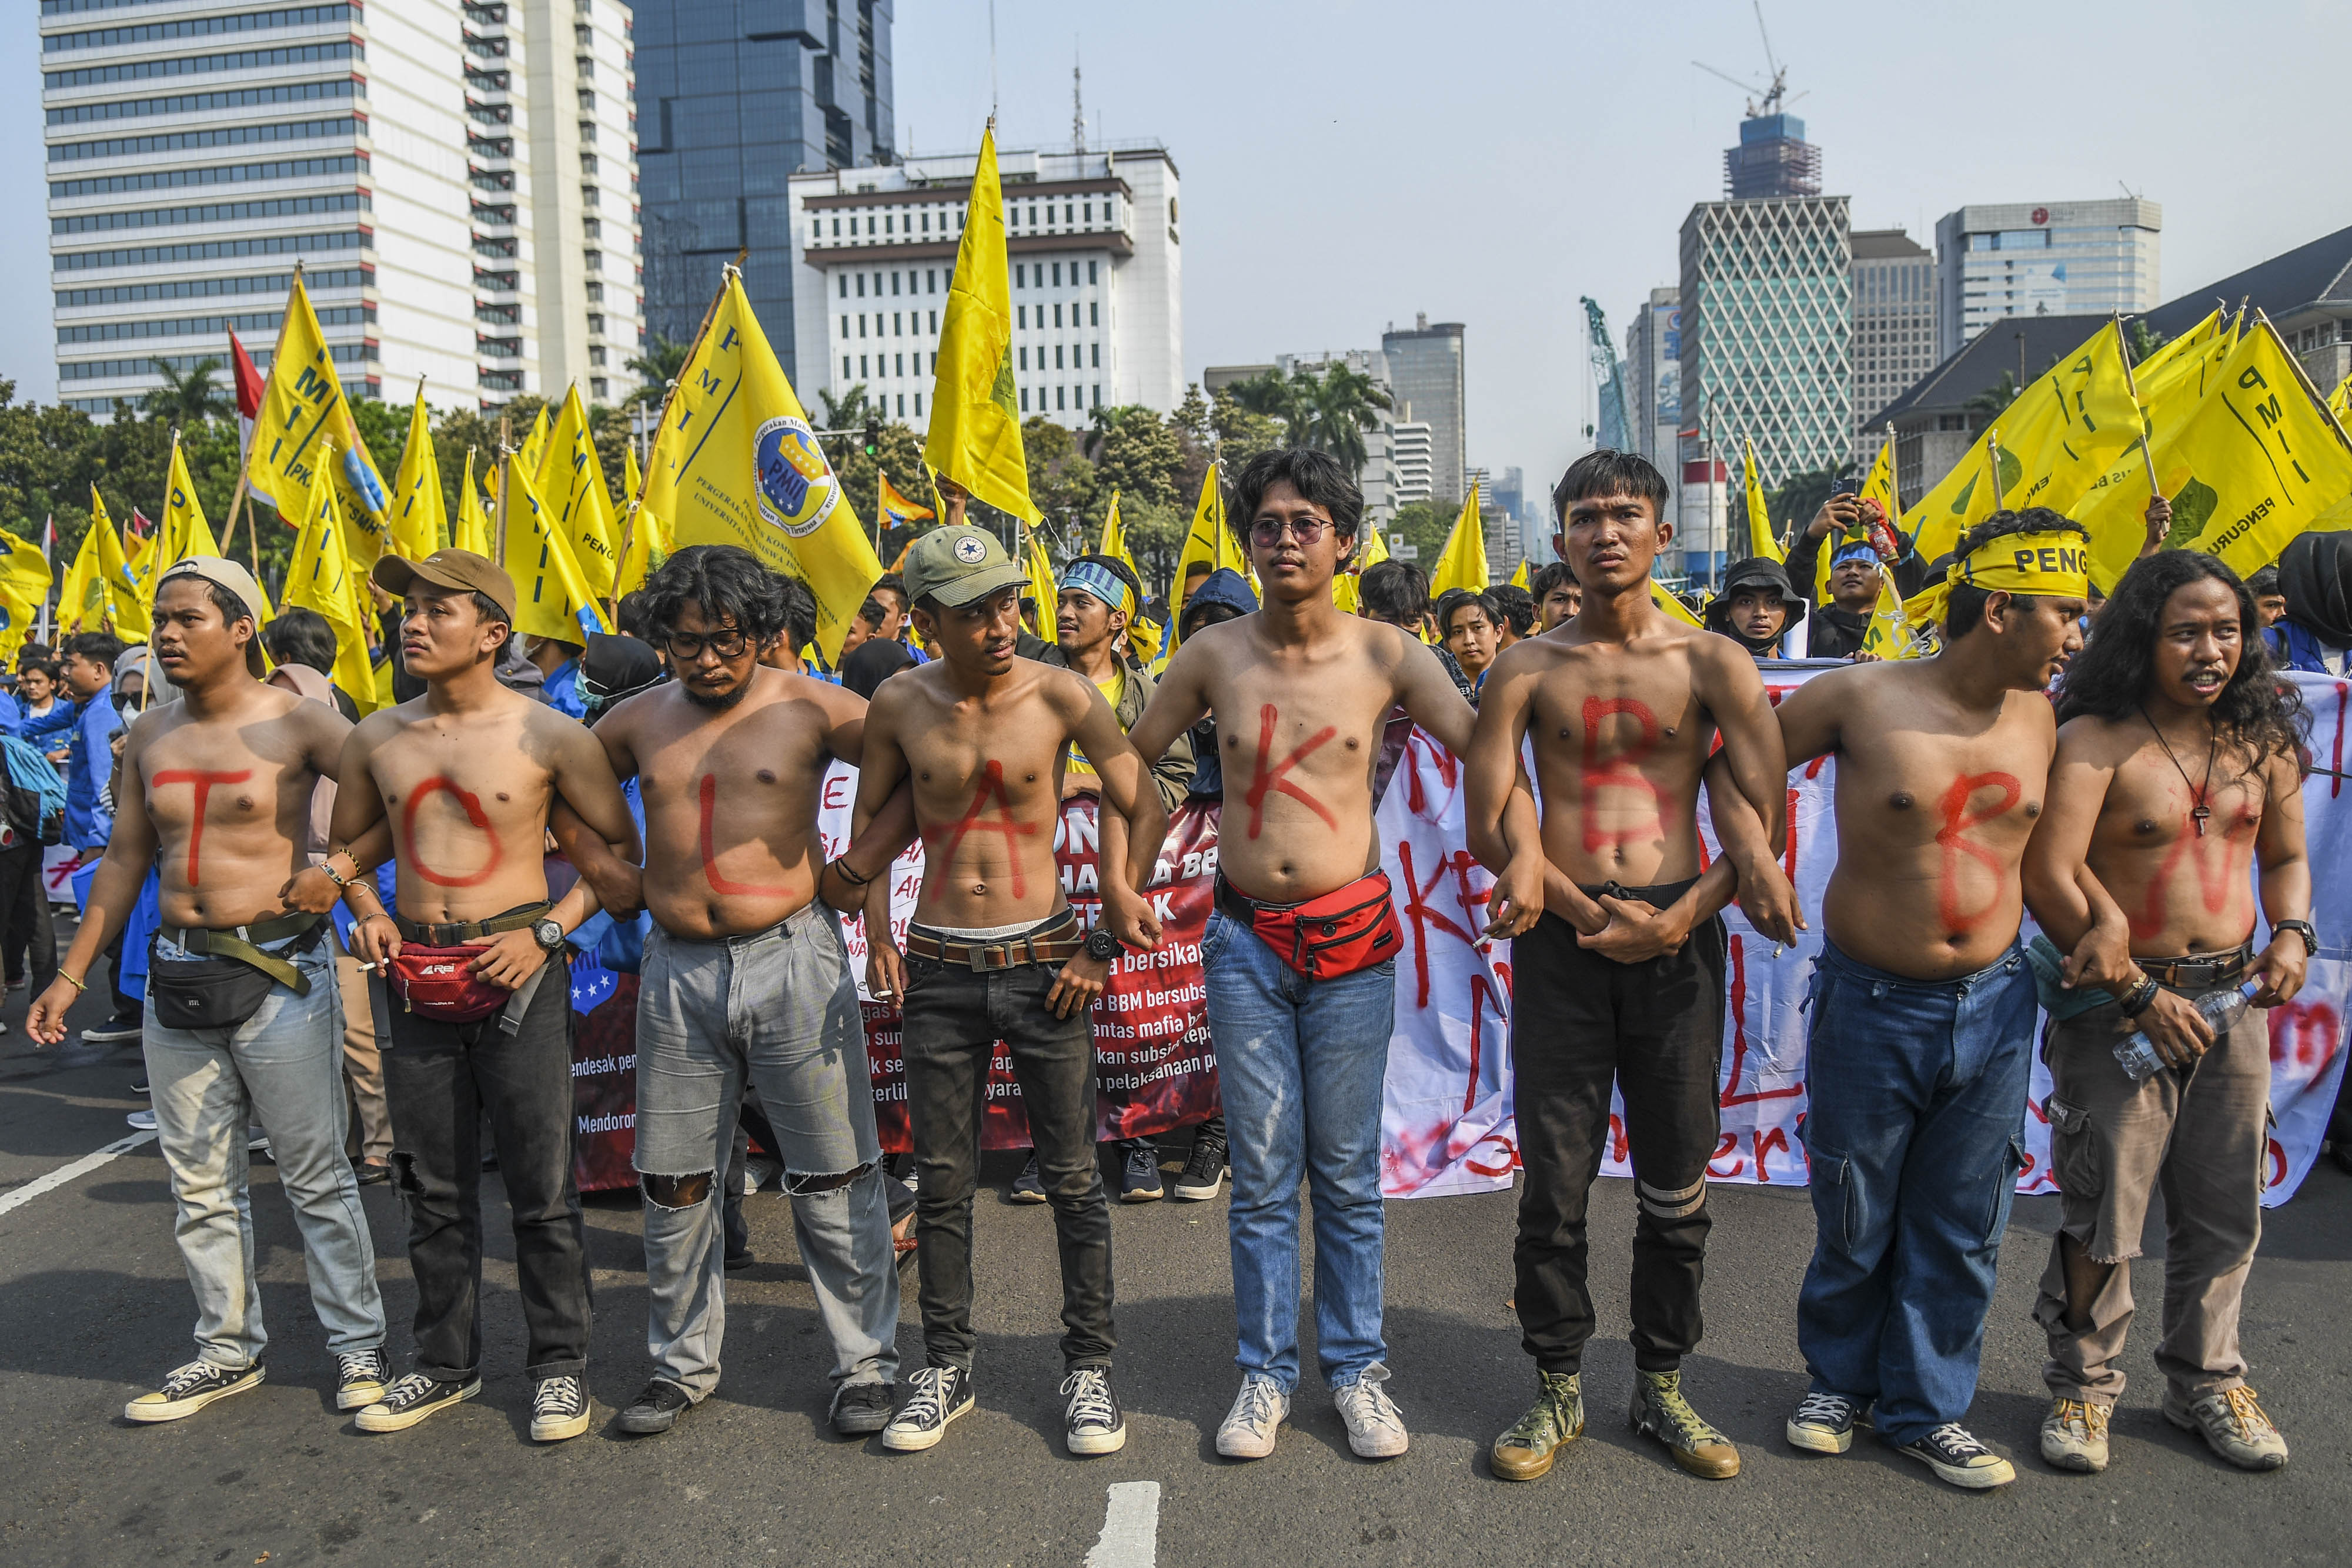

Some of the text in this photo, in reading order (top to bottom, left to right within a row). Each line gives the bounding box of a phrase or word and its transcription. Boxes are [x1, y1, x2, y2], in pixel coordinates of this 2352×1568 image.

[270, 347, 330, 464] MII
[670, 325, 740, 470] PMI
[694, 492, 744, 537] UNIVERSITAS
[769, 459, 806, 501] PMII
[152, 768, 253, 887] T
[1244, 704, 1339, 840] K
[1581, 695, 1676, 854] B
[403, 775, 503, 887] O
[699, 773, 795, 897] L
[923, 760, 1038, 904] A
[1935, 772, 2022, 931] B
[1094, 1047, 1125, 1065] kan
[1108, 991, 1142, 1012] BBM
[1140, 1015, 1184, 1038] mafia
[985, 1082, 1022, 1101] yara
[1107, 1057, 1201, 1092] pelaksanaan
